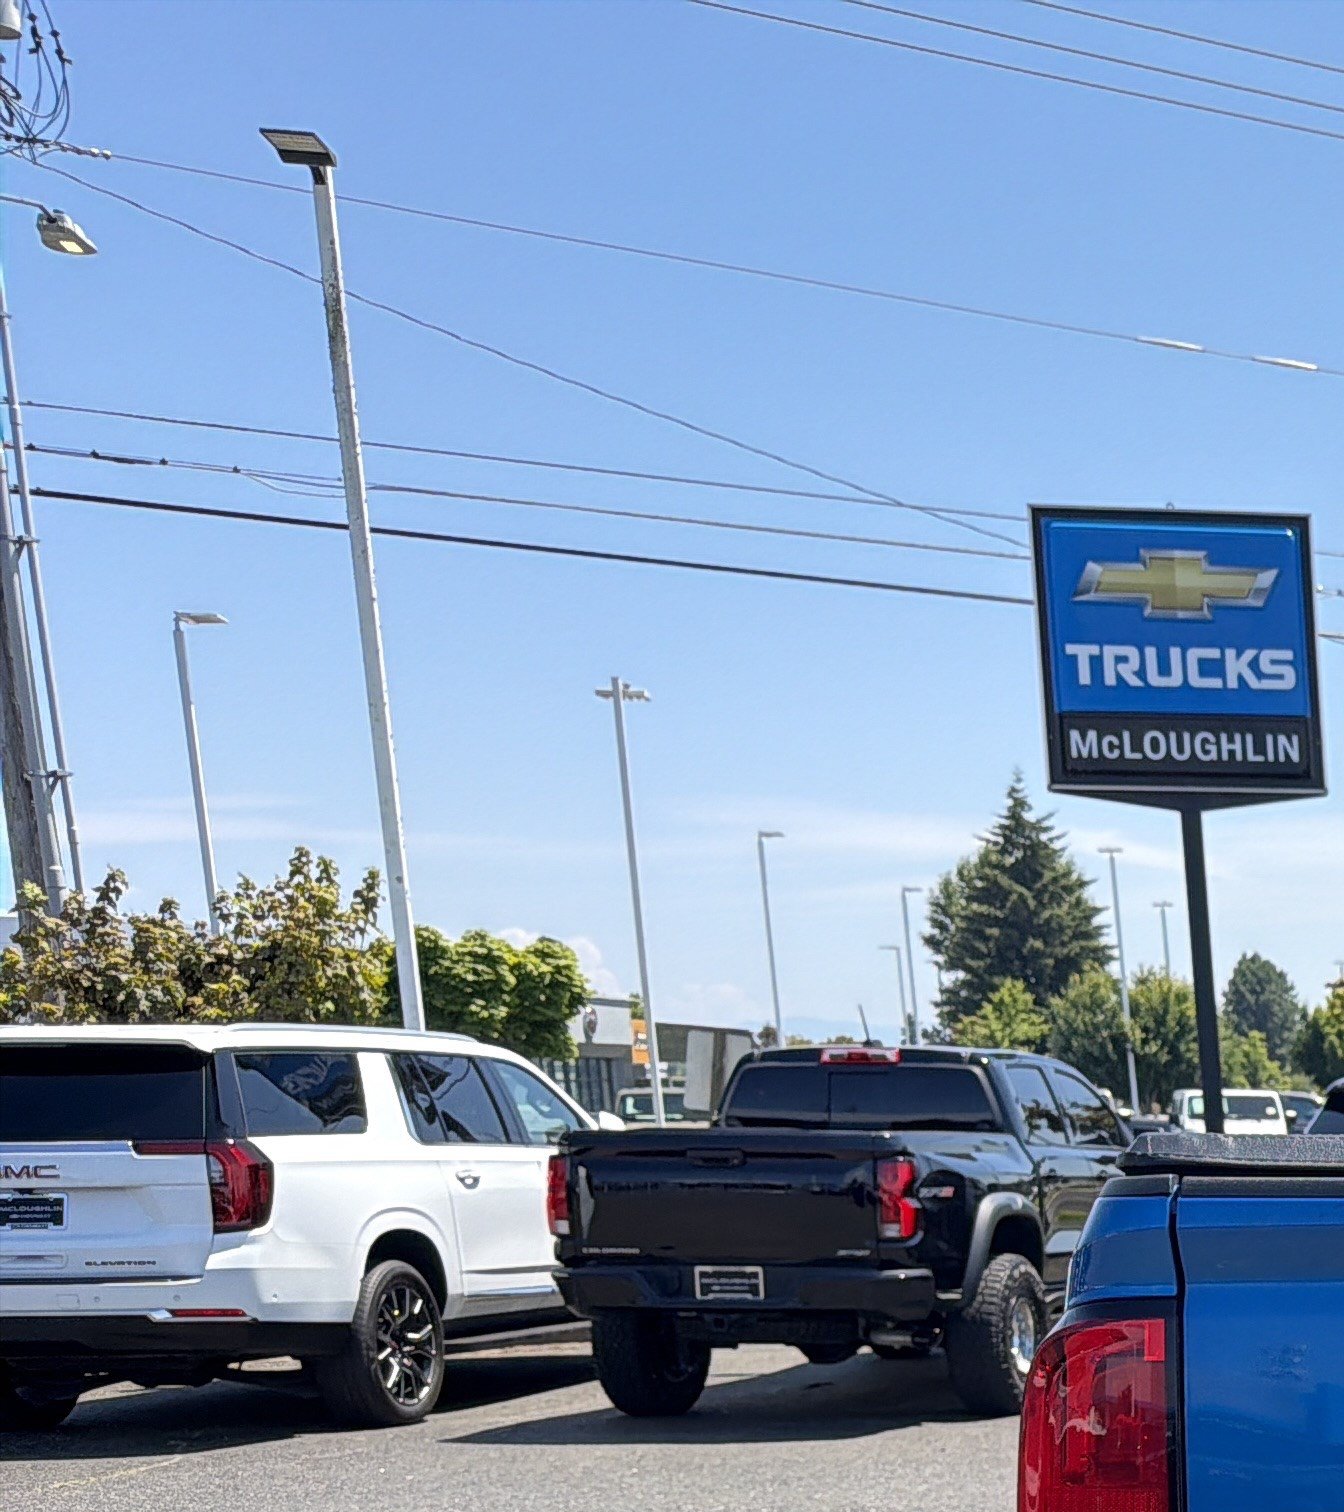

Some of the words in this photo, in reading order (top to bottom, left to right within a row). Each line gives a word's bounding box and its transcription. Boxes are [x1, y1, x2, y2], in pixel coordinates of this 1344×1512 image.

[1065, 643, 1296, 690] TRUCKS
[1068, 729, 1300, 763] McLOUGHLIN
[0, 1164, 60, 1178] MC
